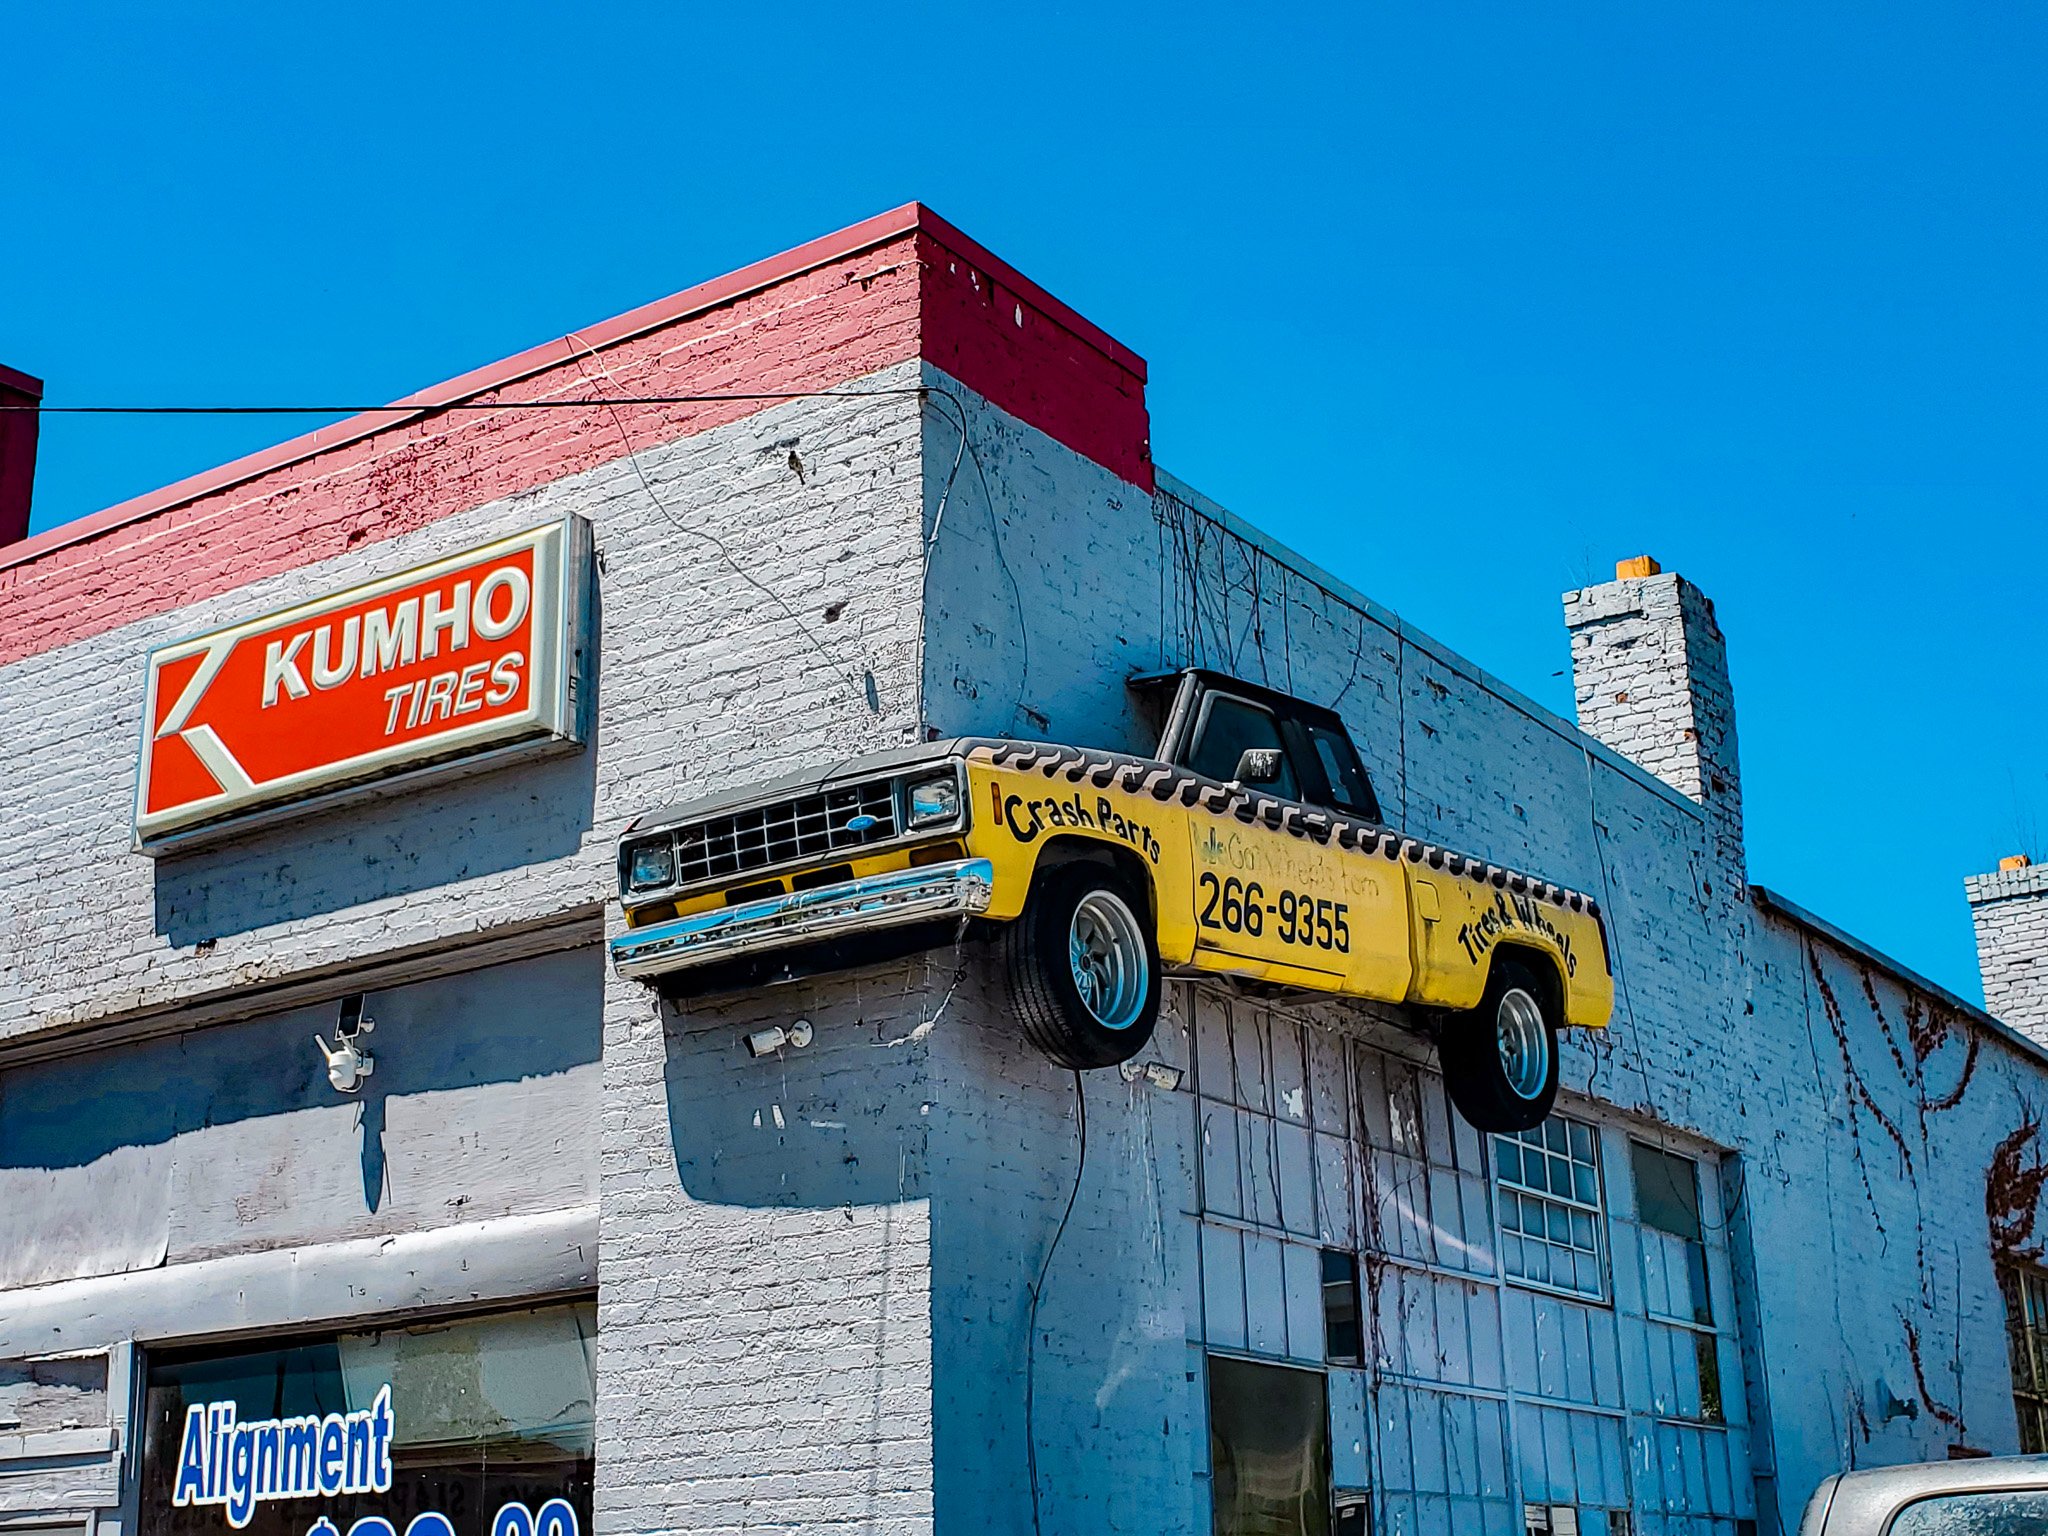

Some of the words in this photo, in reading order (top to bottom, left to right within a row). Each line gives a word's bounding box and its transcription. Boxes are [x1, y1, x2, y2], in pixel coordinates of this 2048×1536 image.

[262, 565, 531, 710] KUMHO
[384, 651, 525, 736] TIRES
[1004, 792, 1096, 843] Crash
[1096, 796, 1161, 865] Parts
[1199, 871, 1350, 955] 266-9355
[1457, 905, 1499, 966] Tires
[1494, 890, 1515, 927] &
[1509, 890, 1578, 979] Wheels
[173, 1382, 395, 1530] Alignment
